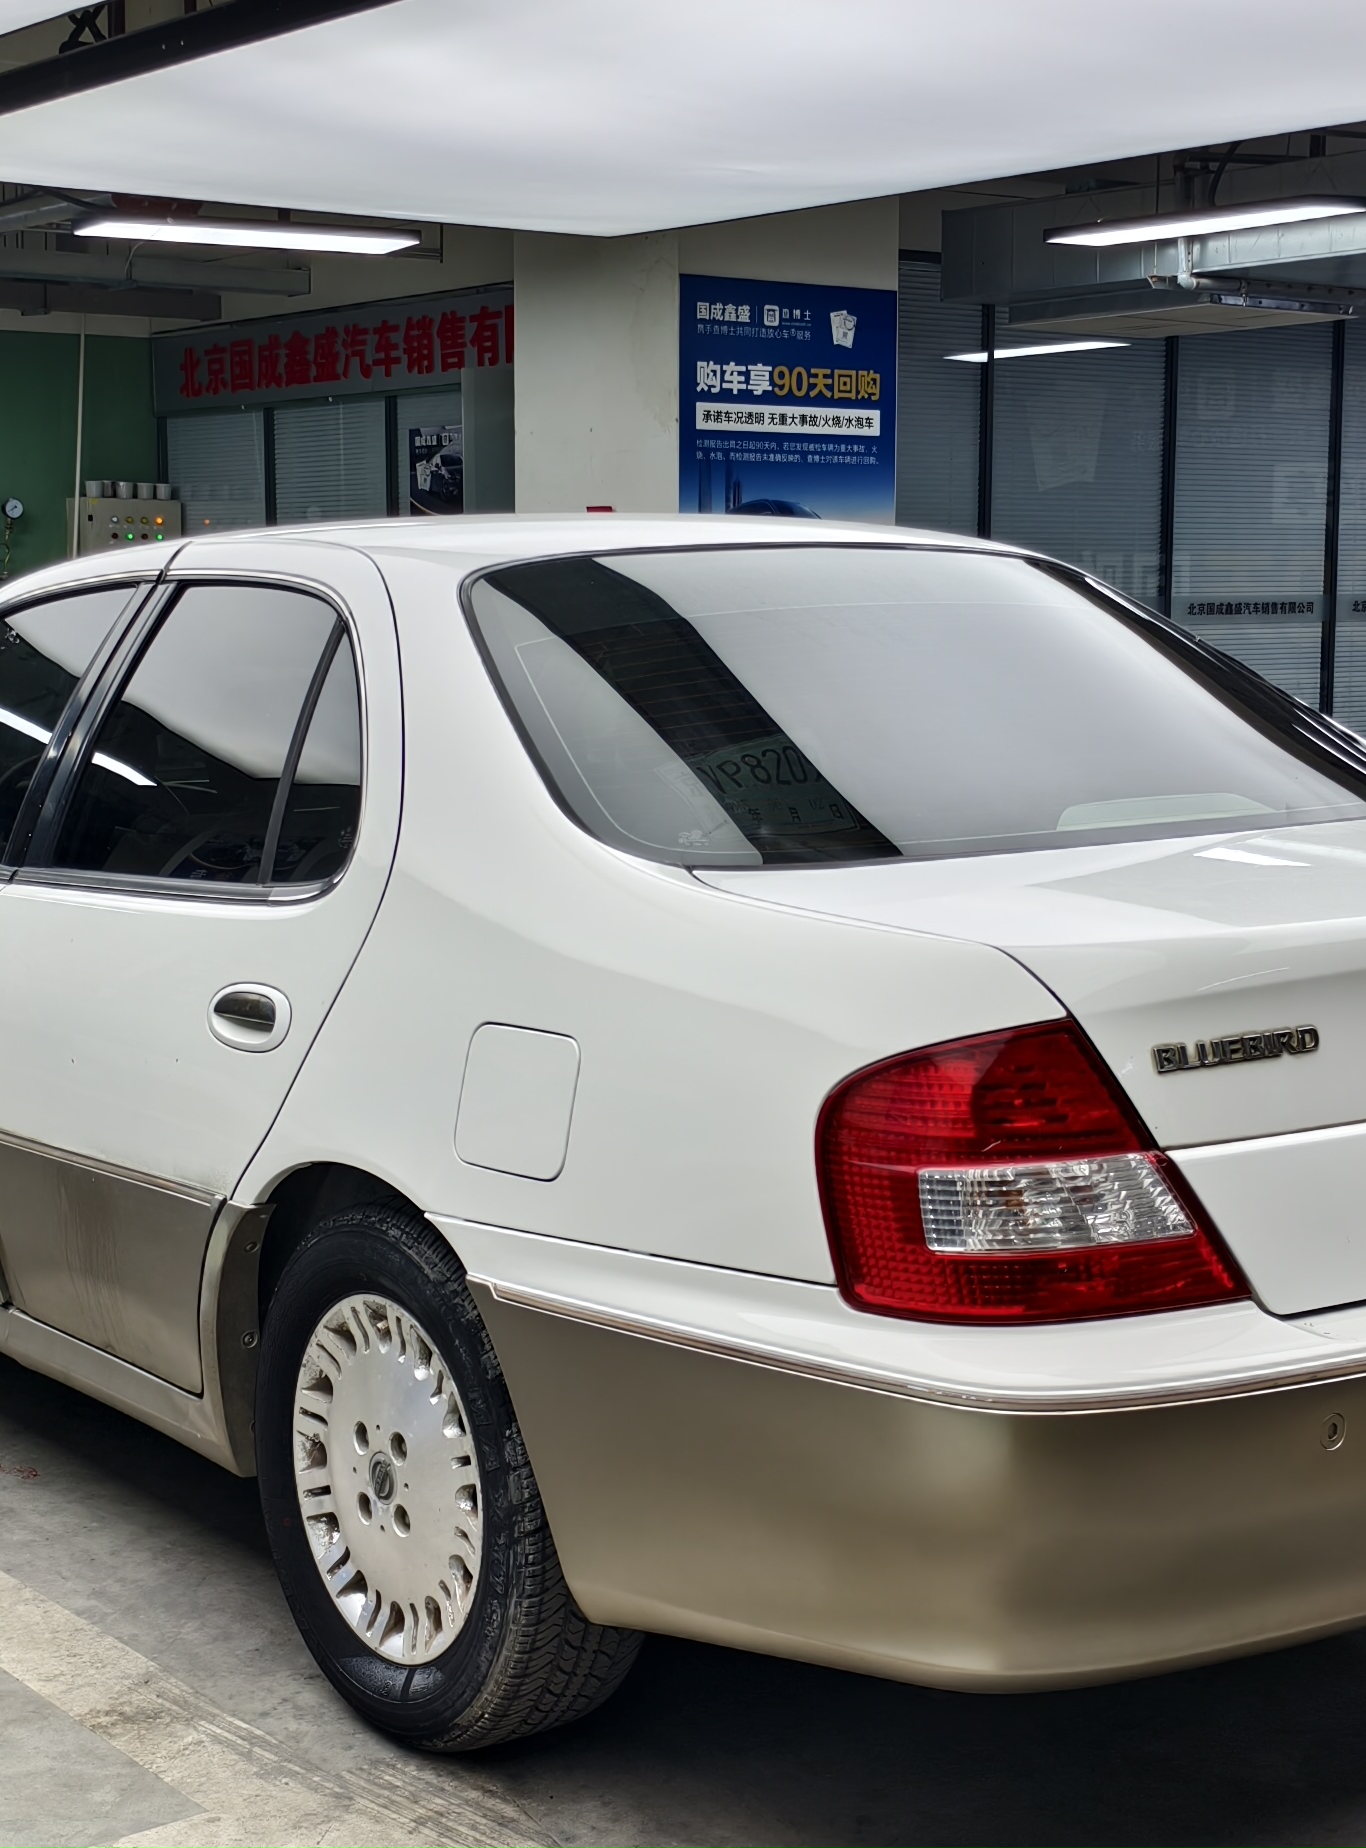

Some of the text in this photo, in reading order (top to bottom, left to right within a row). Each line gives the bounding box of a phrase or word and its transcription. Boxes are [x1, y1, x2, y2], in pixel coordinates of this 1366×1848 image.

[696, 302, 751, 322] 国成鑫盛
[179, 303, 514, 398] 北京国成鑫盛汽车销售有
[696, 361, 881, 401] 购车享90天回购
[702, 410, 875, 430] 承诺车况透明 无重大事故/火烧/水泡车
[1152, 1024, 1320, 1074] BLUEBIRD
